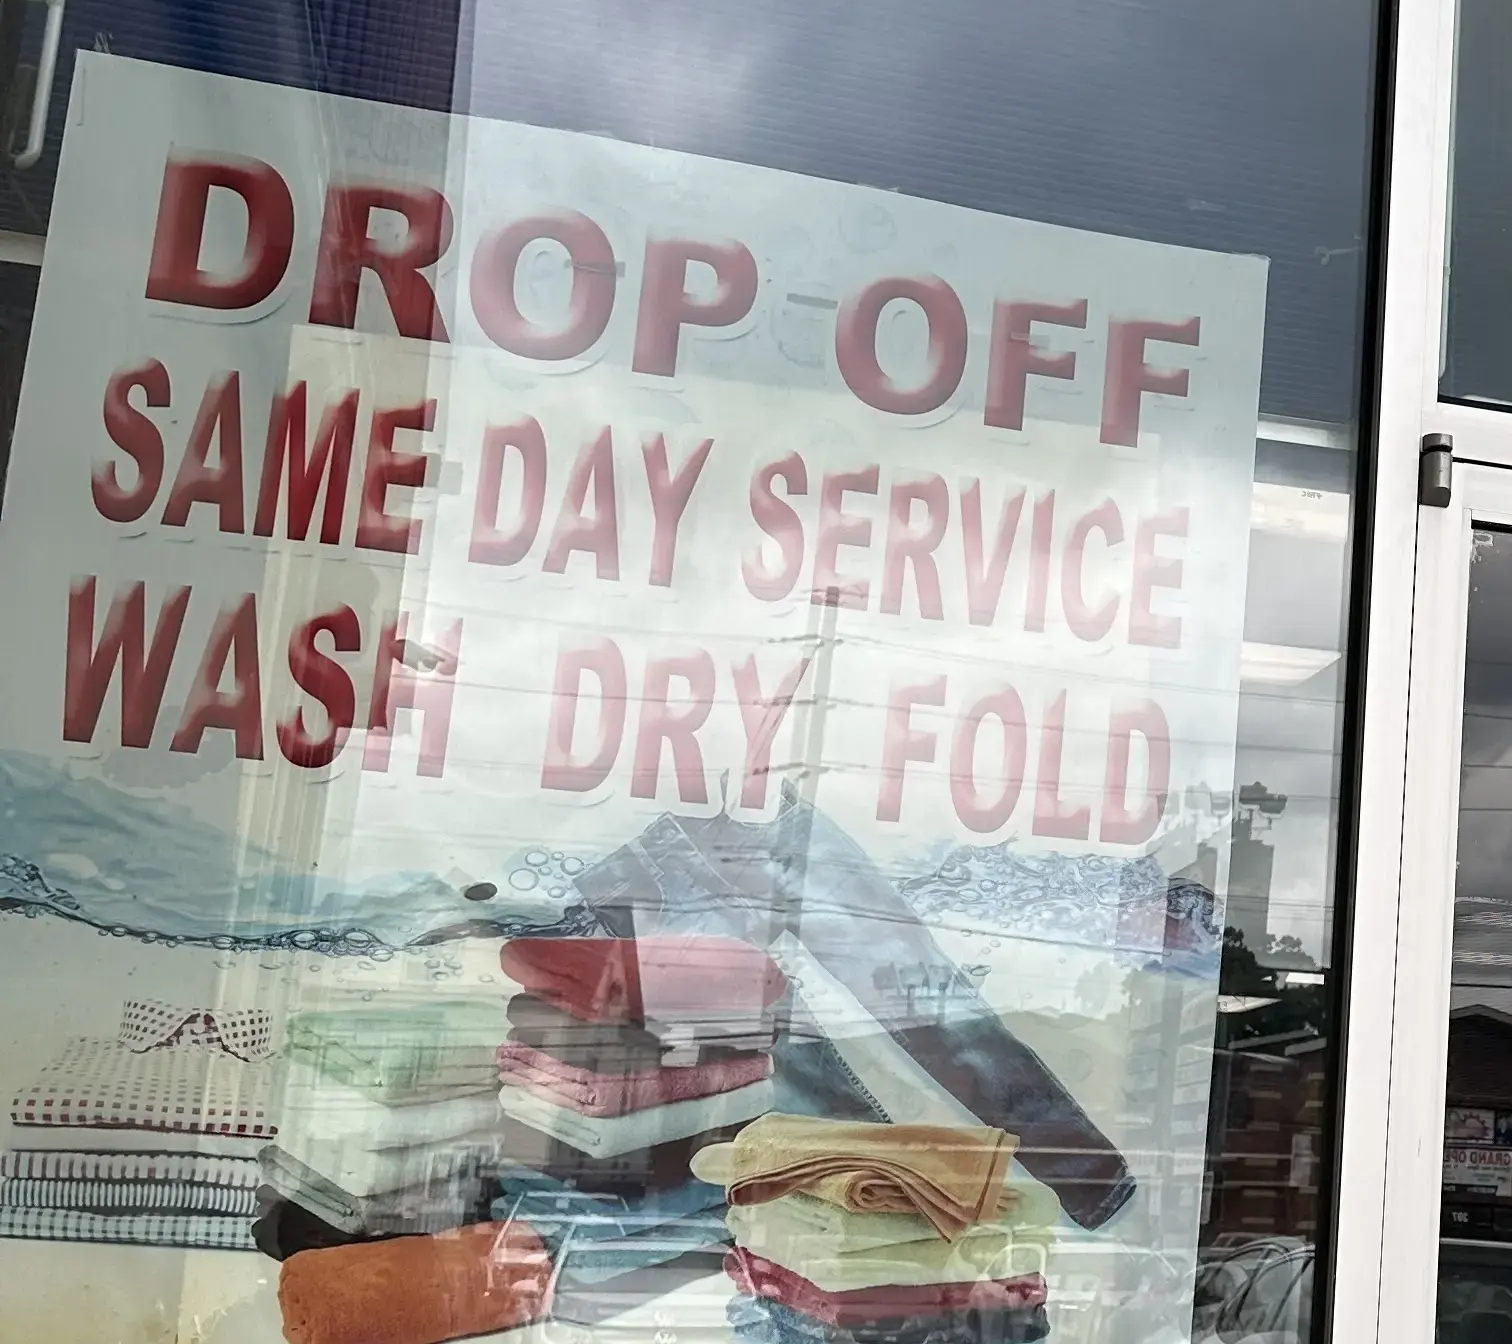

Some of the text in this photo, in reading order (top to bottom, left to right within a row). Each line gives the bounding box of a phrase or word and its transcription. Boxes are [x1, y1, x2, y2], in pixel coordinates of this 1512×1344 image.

[145, 150, 1201, 448] DROP OFF
[91, 356, 1190, 650] SAME DAY SERVICE
[62, 575, 1172, 846] WASH DRY FOLD
